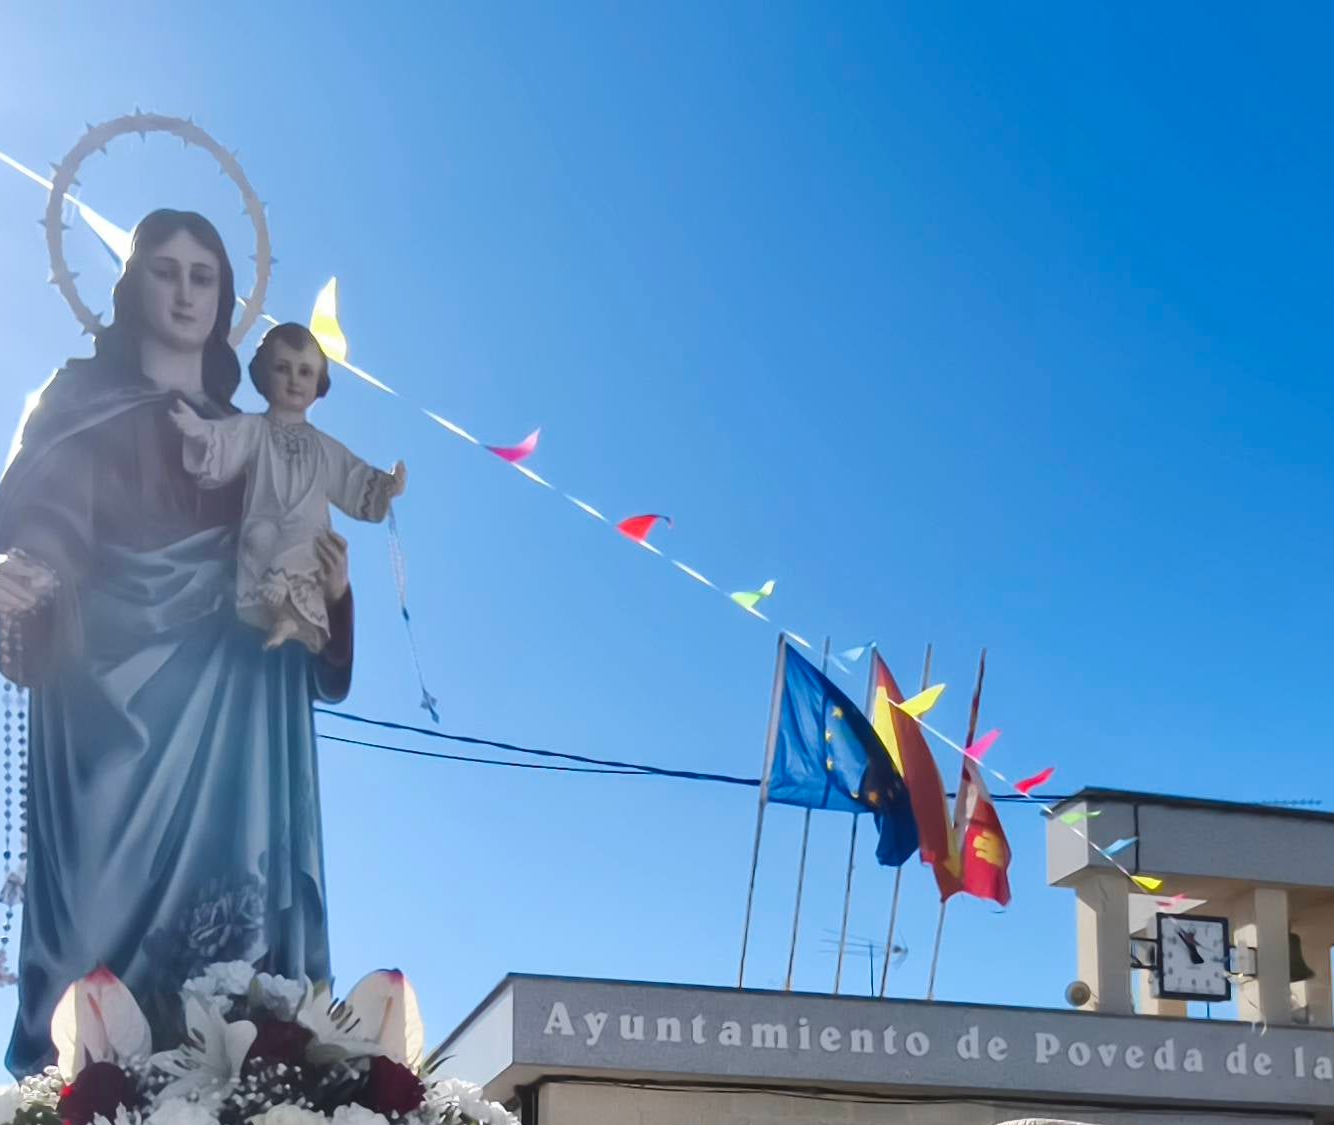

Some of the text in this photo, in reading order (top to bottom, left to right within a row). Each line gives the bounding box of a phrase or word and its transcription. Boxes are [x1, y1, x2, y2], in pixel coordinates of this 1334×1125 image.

[543, 1002, 931, 1057] Ayuntamiento
[957, 1026, 1010, 1062] de
[1035, 1031, 1204, 1073] Poveda
[1226, 1043, 1273, 1076] de
